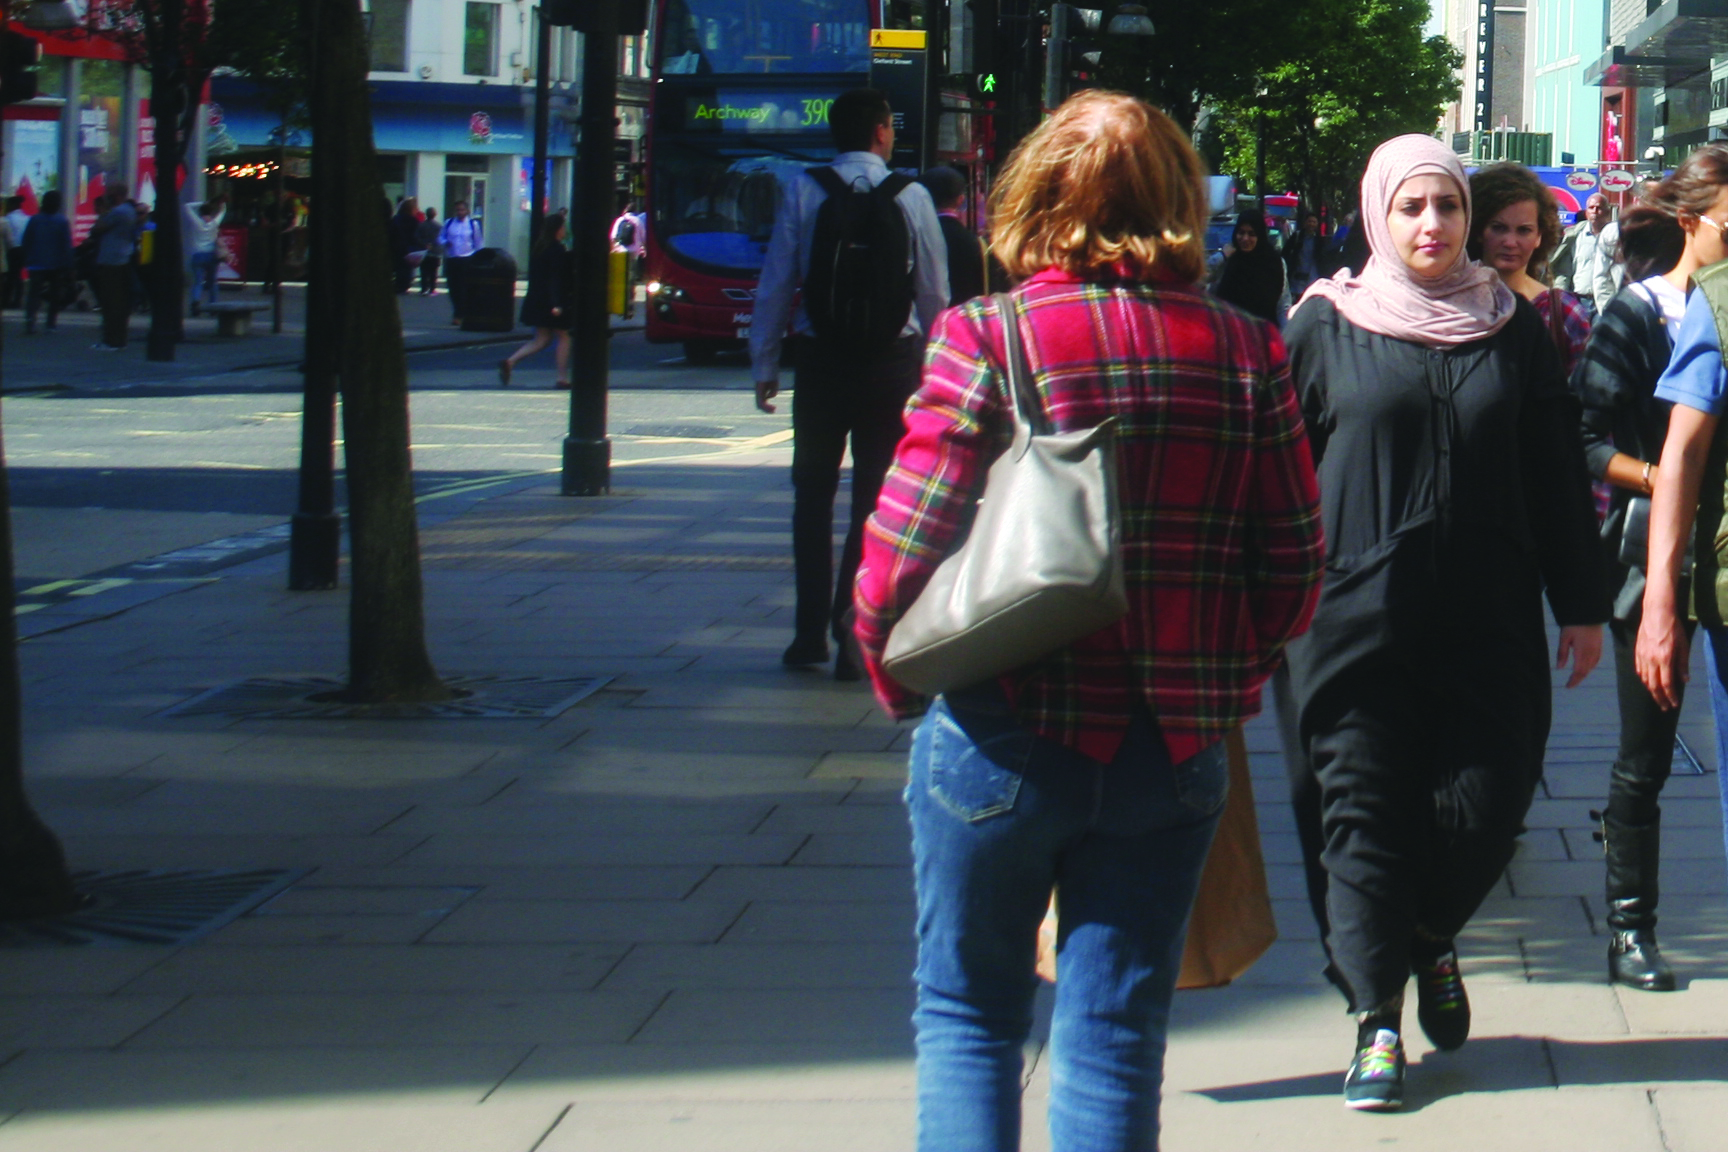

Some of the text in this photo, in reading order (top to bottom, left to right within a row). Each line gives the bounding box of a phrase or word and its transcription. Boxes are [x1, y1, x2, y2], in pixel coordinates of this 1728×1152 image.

[694, 103, 771, 124] Archway
[1476, 102, 1485, 131] 21
[1566, 174, 1595, 189] Disney
[1600, 174, 1632, 188] Disney
